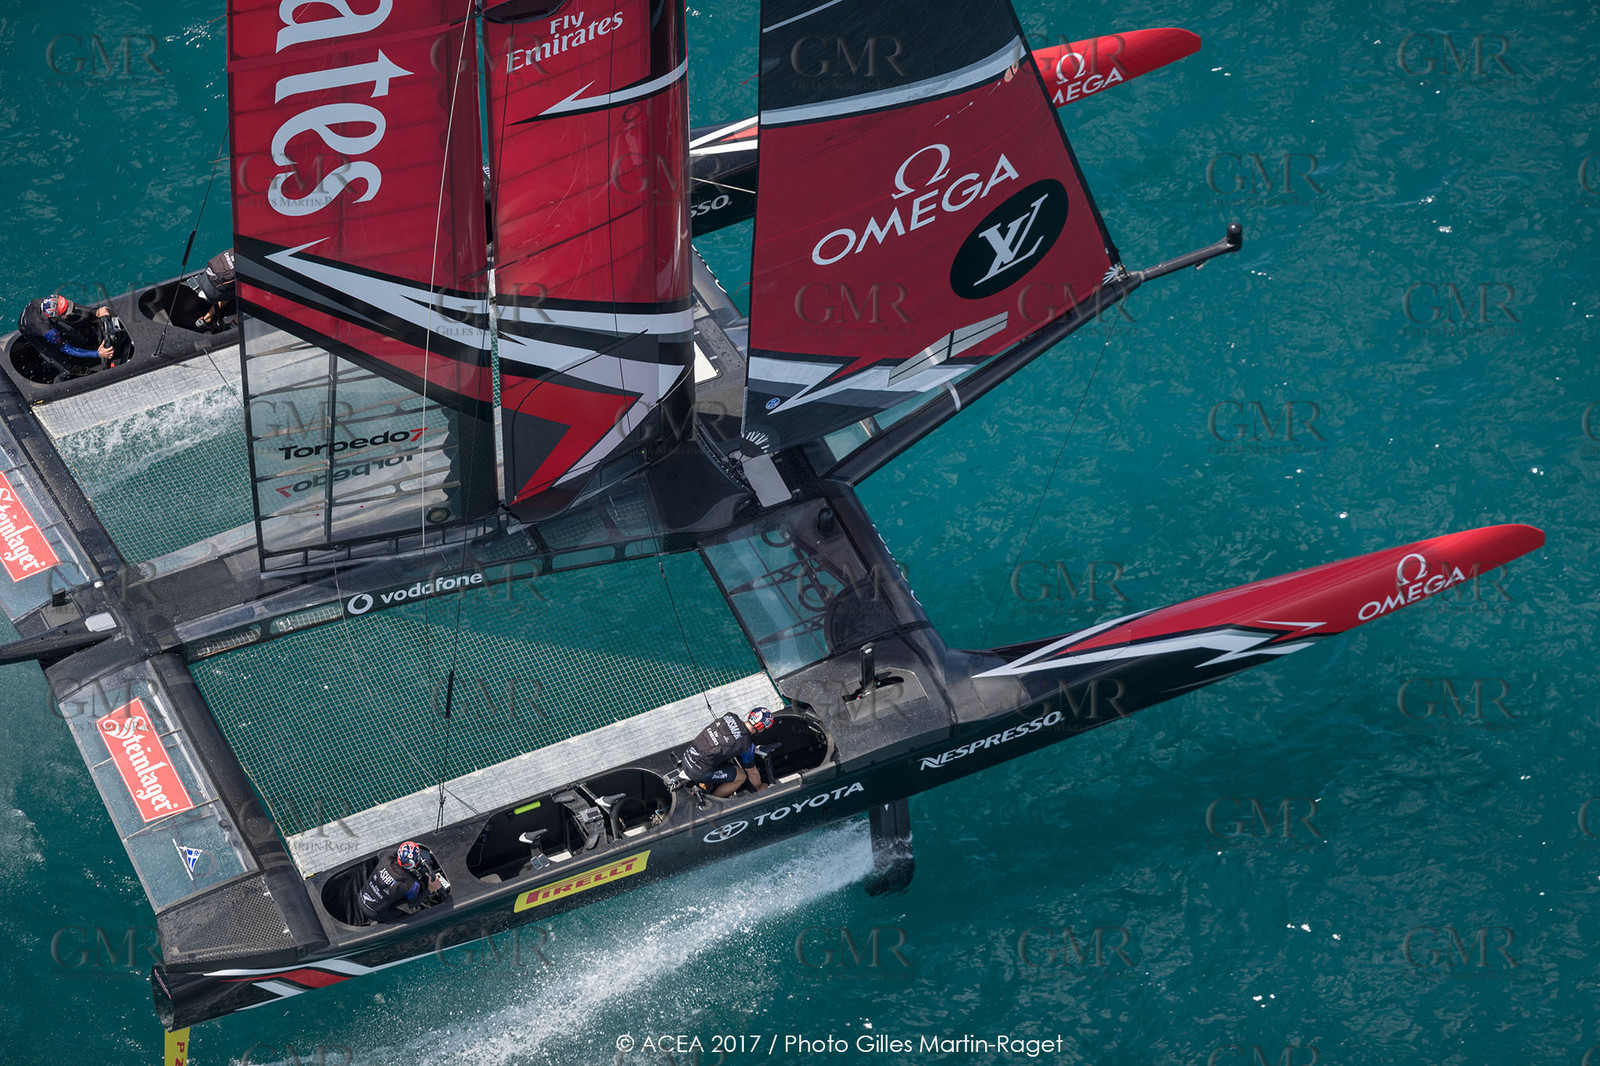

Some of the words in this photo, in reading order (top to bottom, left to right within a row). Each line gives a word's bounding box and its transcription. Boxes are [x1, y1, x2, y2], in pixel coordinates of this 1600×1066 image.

[506, 12, 623, 73] Emirates
[550, 11, 584, 34] Fly
[268, 0, 415, 216] ates
[1052, 66, 1123, 104] EGA
[812, 153, 1019, 266] OMEGA
[278, 427, 429, 461] Torpedo7
[380, 573, 482, 604] vodafone
[1358, 566, 1465, 620] OMEGA
[103, 716, 178, 812] Steinlager
[754, 782, 865, 827] TOYOTA
[526, 857, 638, 905] PIRELLI
